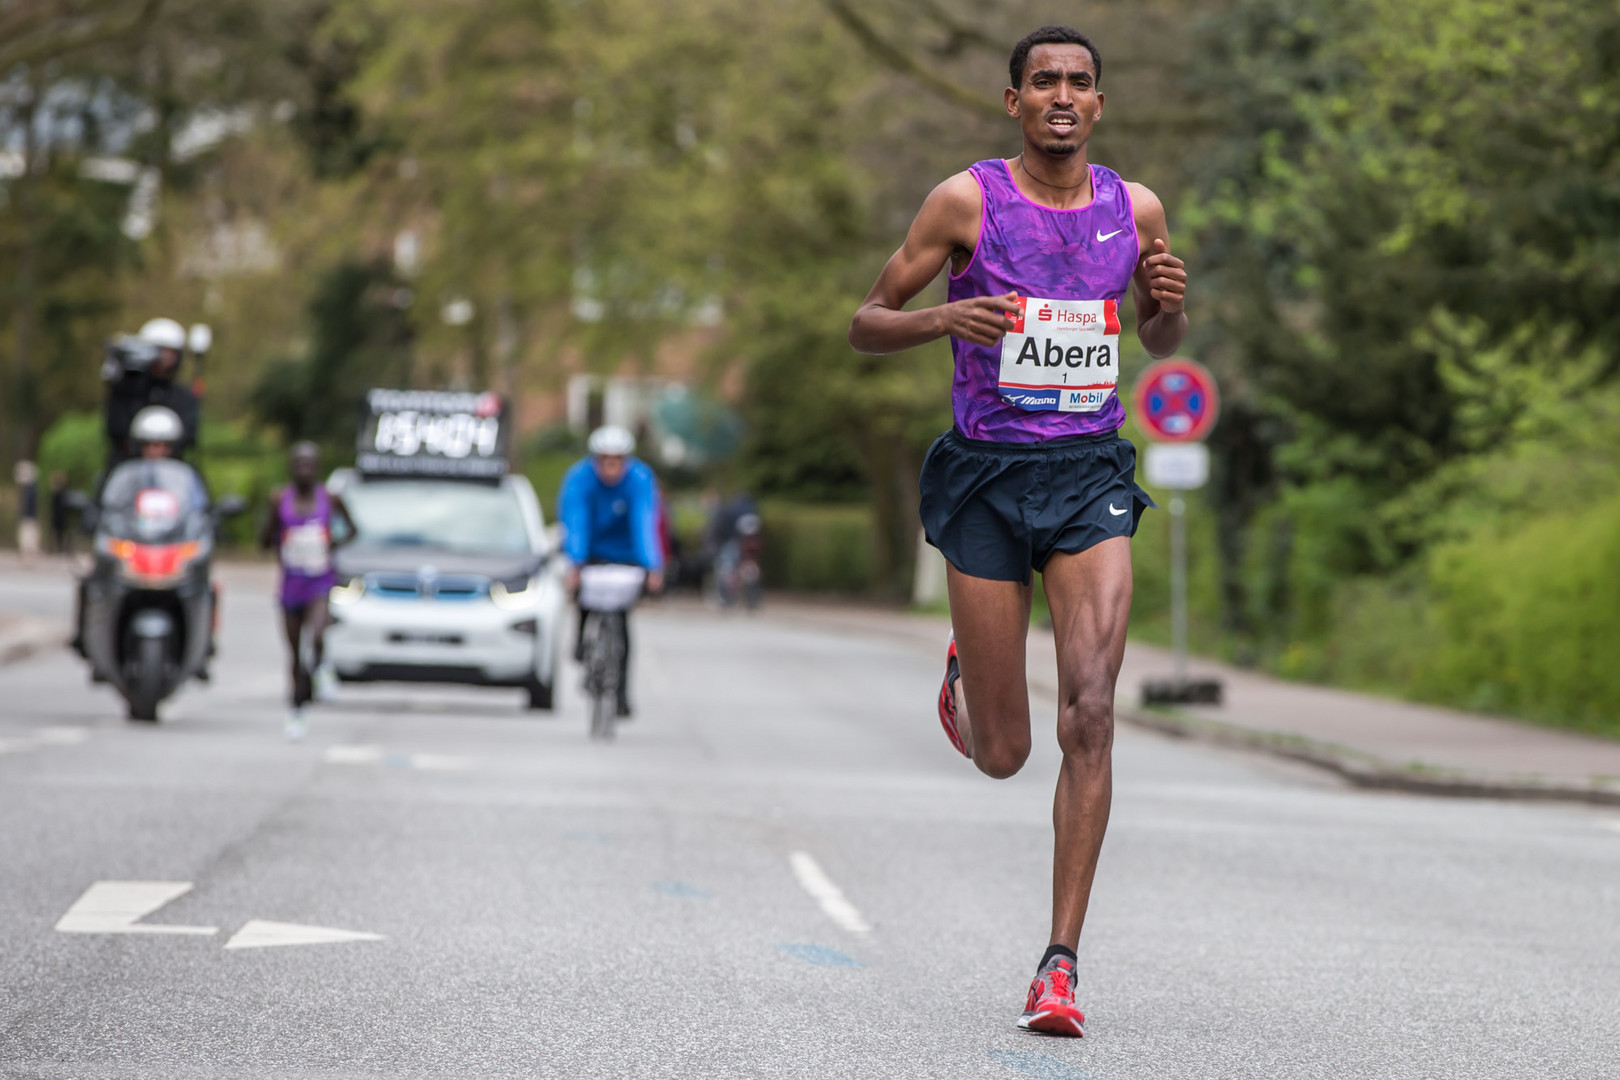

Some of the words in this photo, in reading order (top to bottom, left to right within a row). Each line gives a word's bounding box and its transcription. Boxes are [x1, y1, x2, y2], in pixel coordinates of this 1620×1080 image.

[1057, 310, 1097, 326] Haspa
[1015, 336, 1111, 368] Abera
[1062, 372, 1067, 383] 1
[1069, 392, 1103, 403] Mobil
